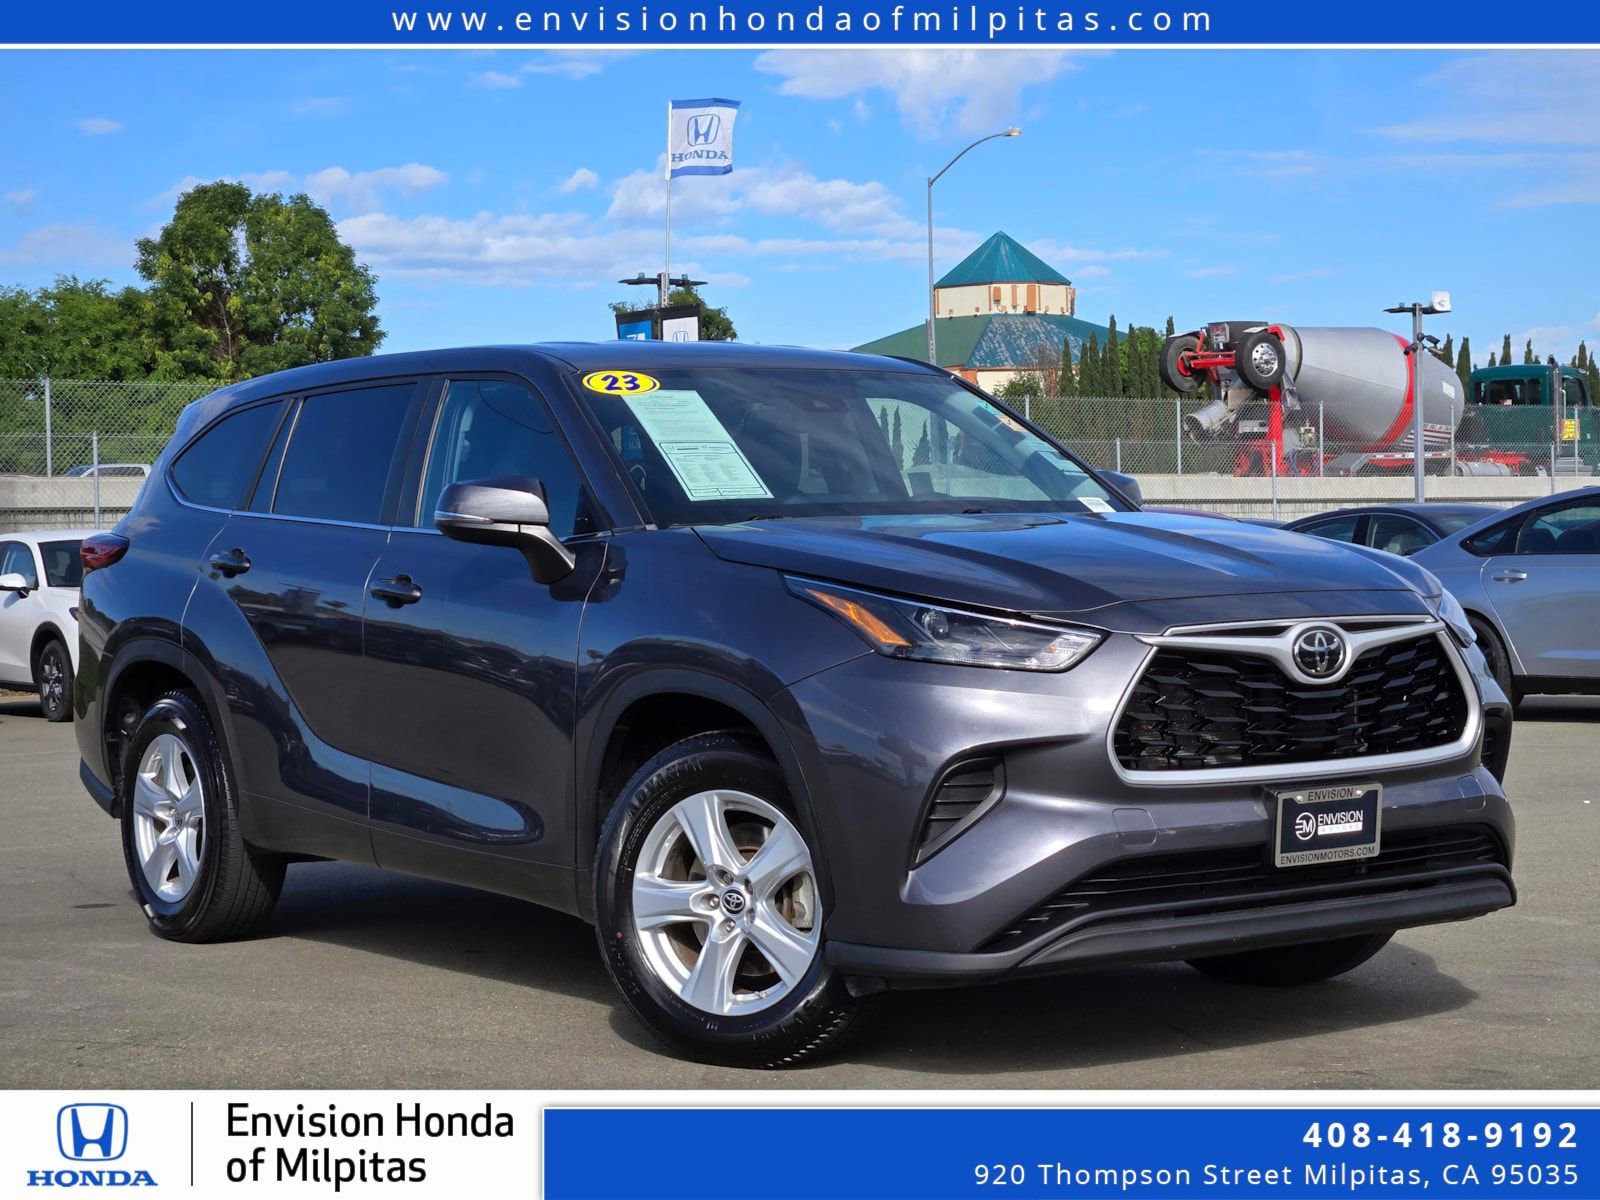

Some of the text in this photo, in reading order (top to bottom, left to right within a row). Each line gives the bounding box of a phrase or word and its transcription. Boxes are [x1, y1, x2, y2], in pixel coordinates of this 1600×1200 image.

[671, 149, 729, 163] HONDA
[601, 375, 640, 391] 23
[1307, 787, 1354, 802] ENVISION
[1317, 810, 1364, 825] ENVISION
[1280, 846, 1375, 865] ENVISIONMOTORS.COM
